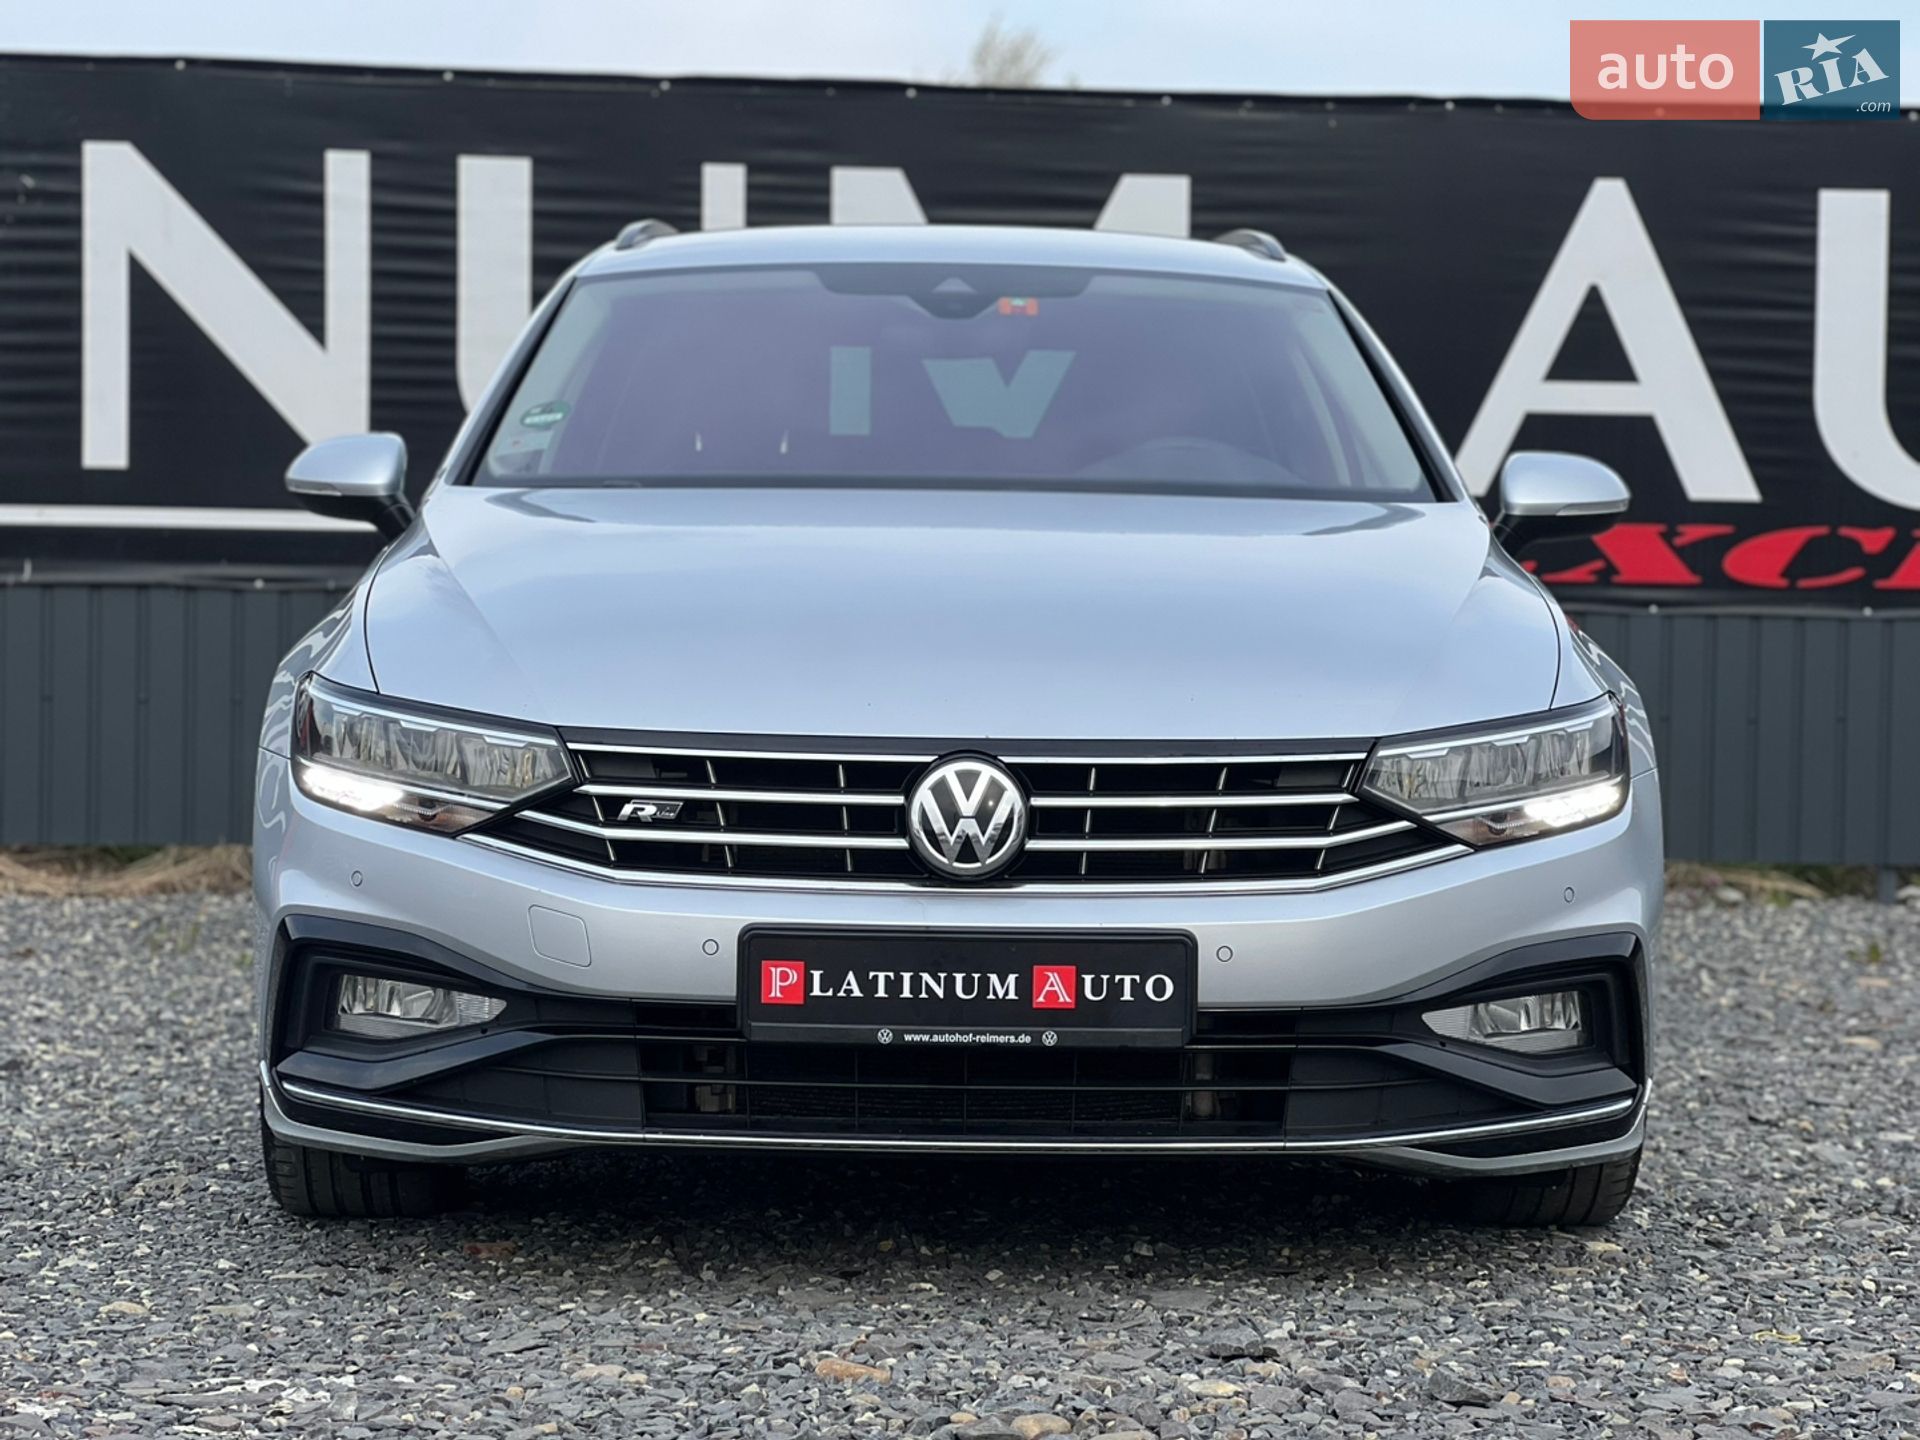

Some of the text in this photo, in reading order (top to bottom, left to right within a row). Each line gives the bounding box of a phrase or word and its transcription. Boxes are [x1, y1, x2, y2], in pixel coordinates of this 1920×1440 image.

[768, 966, 1174, 1003] PLATINUM AUTO
[903, 1032, 1032, 1044] www.autohof-reimers.de
